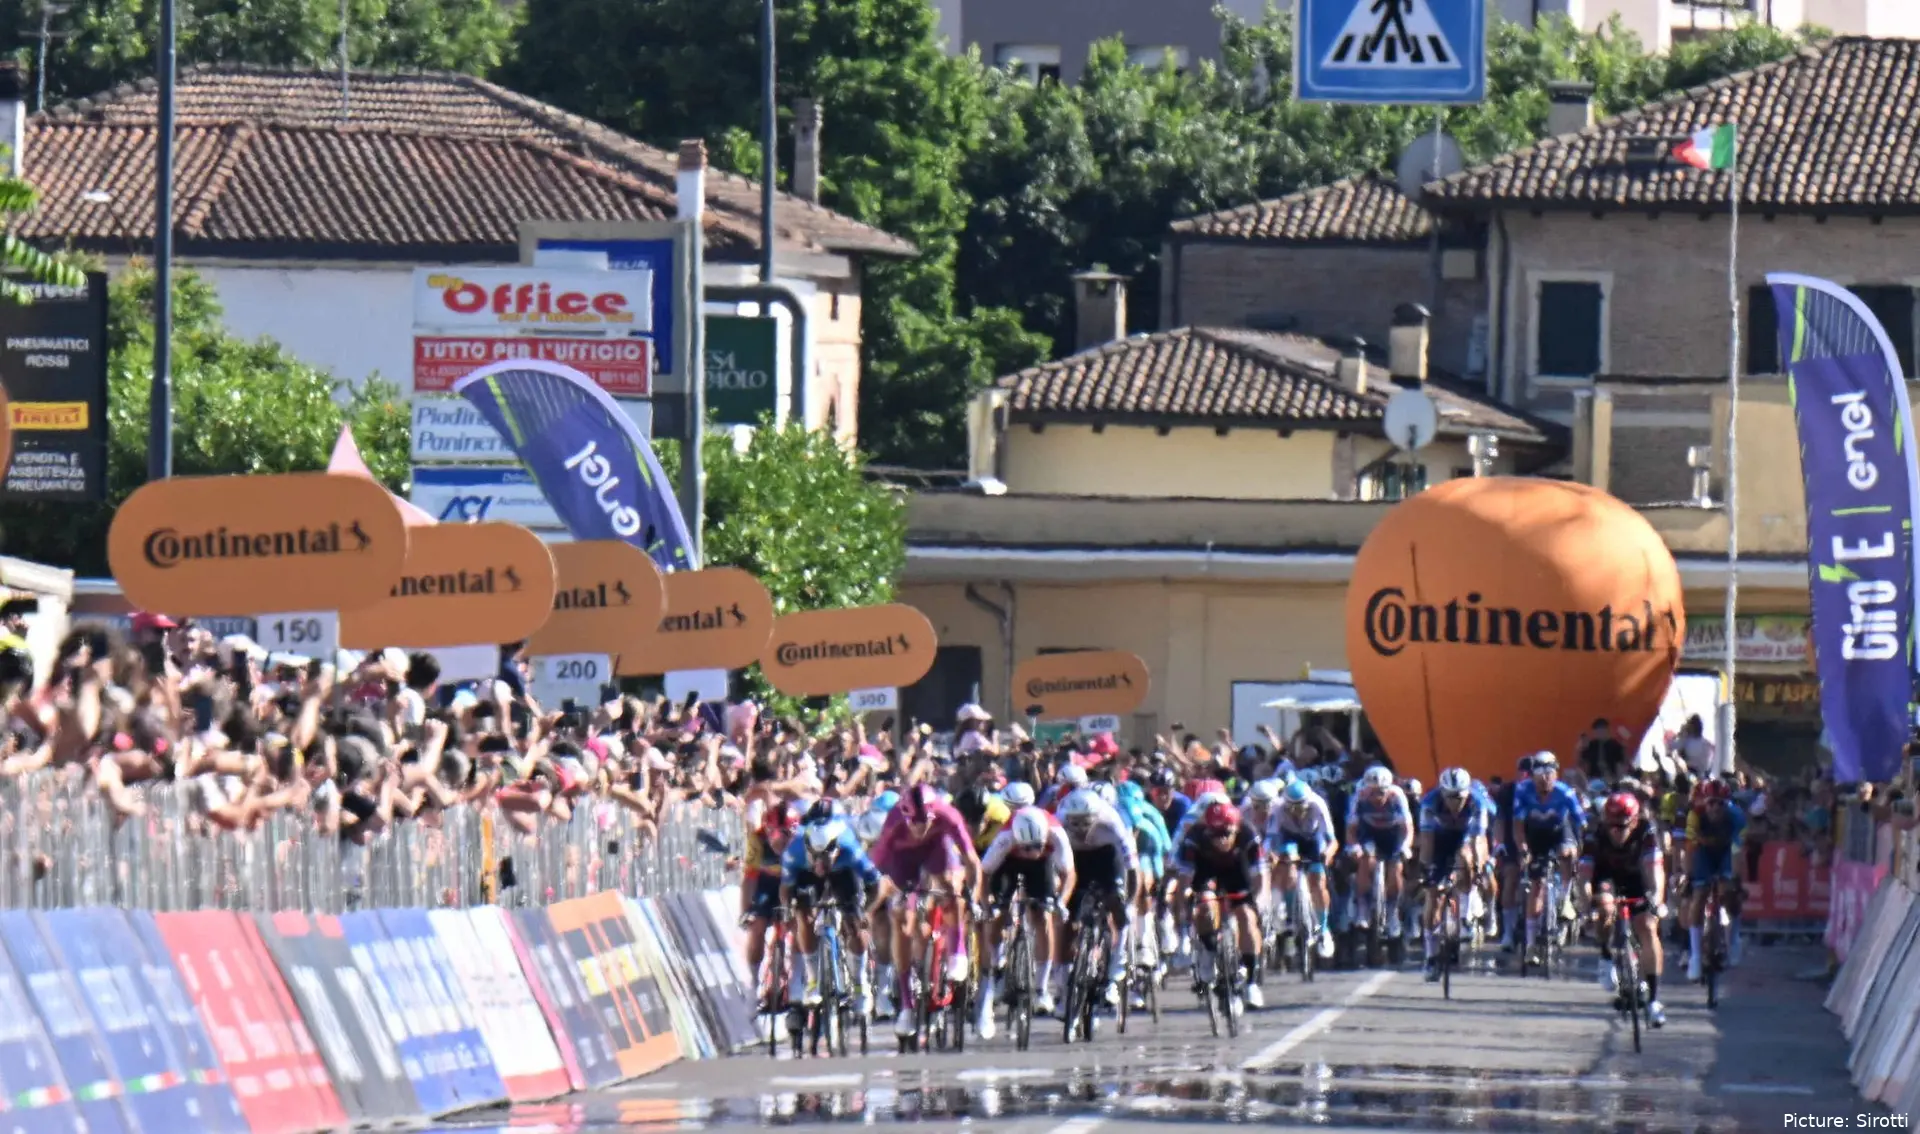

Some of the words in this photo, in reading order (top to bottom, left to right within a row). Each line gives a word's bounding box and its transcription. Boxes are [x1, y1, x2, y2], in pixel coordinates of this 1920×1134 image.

[443, 282, 629, 314] Office
[6, 338, 89, 351] PNEUMATICI
[421, 341, 485, 360] TUTTO
[493, 342, 530, 360] PER
[25, 355, 70, 368] ROSSI
[1831, 390, 1879, 491] enel
[563, 441, 641, 537] enel
[438, 496, 494, 521] ACI
[143, 522, 340, 569] Continental
[390, 567, 495, 597] nental
[273, 619, 321, 644] 150
[1365, 587, 1656, 657] Continental
[1842, 579, 1899, 661] Giro
[777, 637, 894, 666] Continental
[556, 660, 598, 681] 200
[1026, 673, 1117, 698] Continental
